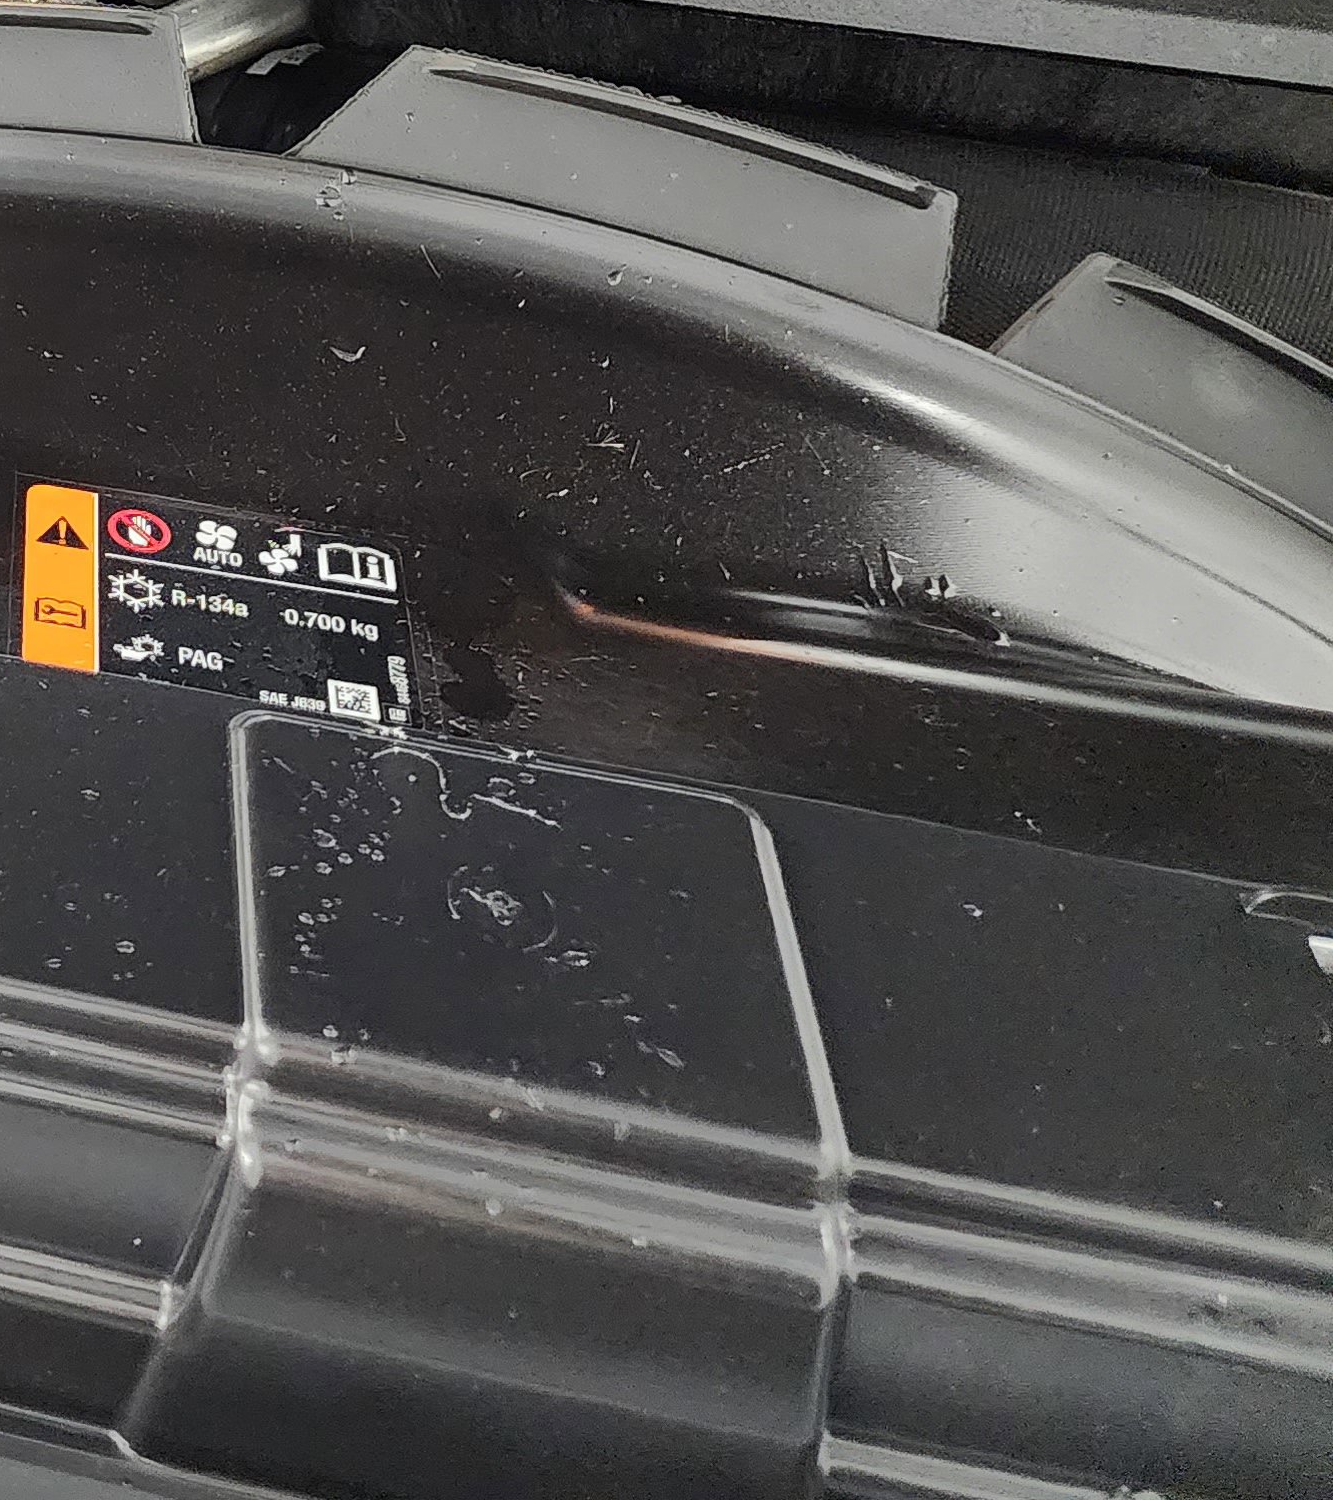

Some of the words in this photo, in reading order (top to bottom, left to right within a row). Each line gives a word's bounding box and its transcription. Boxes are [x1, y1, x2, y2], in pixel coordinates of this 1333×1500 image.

[193, 546, 243, 567] AUTO
[171, 589, 250, 618] R-134a
[284, 608, 346, 633] 0.700
[351, 619, 379, 642] kg
[178, 646, 224, 672] PAG
[259, 690, 288, 706] SAE
